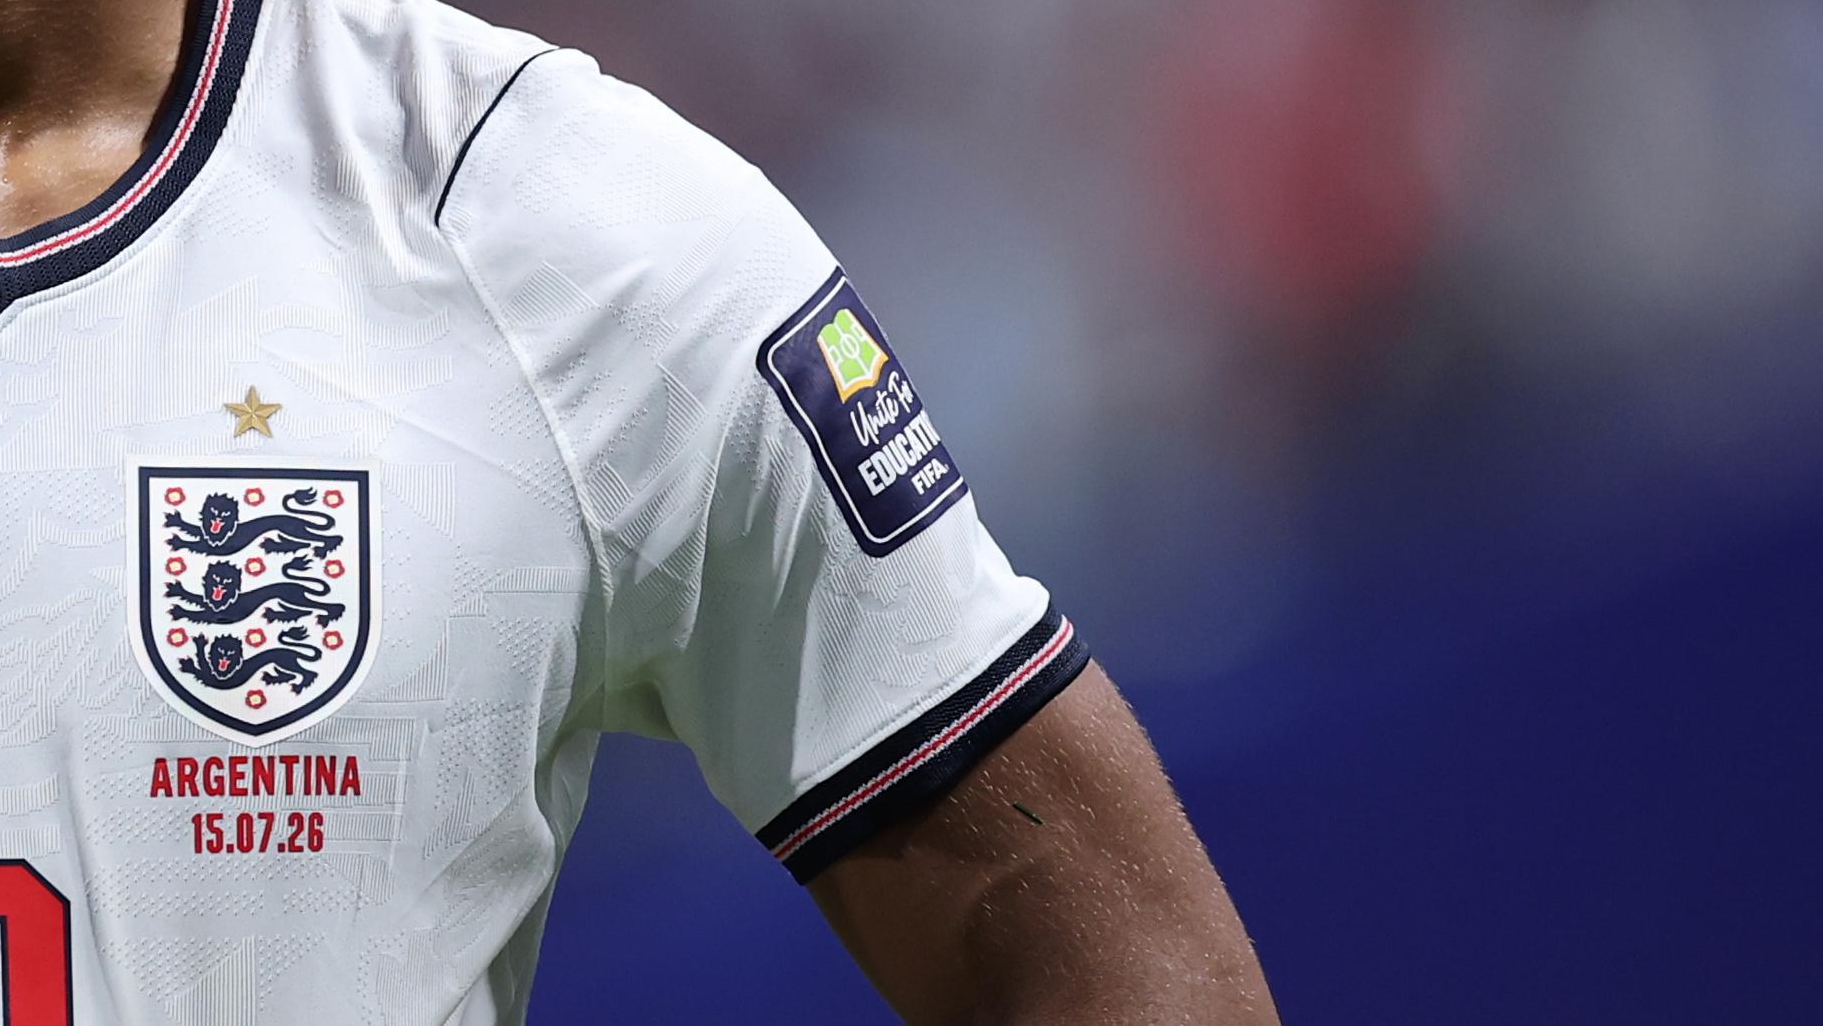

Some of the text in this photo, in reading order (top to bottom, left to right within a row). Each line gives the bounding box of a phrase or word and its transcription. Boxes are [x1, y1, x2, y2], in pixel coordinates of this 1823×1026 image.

[850, 390, 899, 446] Unite
[858, 409, 941, 496] EDUCATI
[911, 458, 948, 495] FIFA
[150, 755, 360, 797] ARGENTINA
[192, 811, 324, 854] 15.07.26
